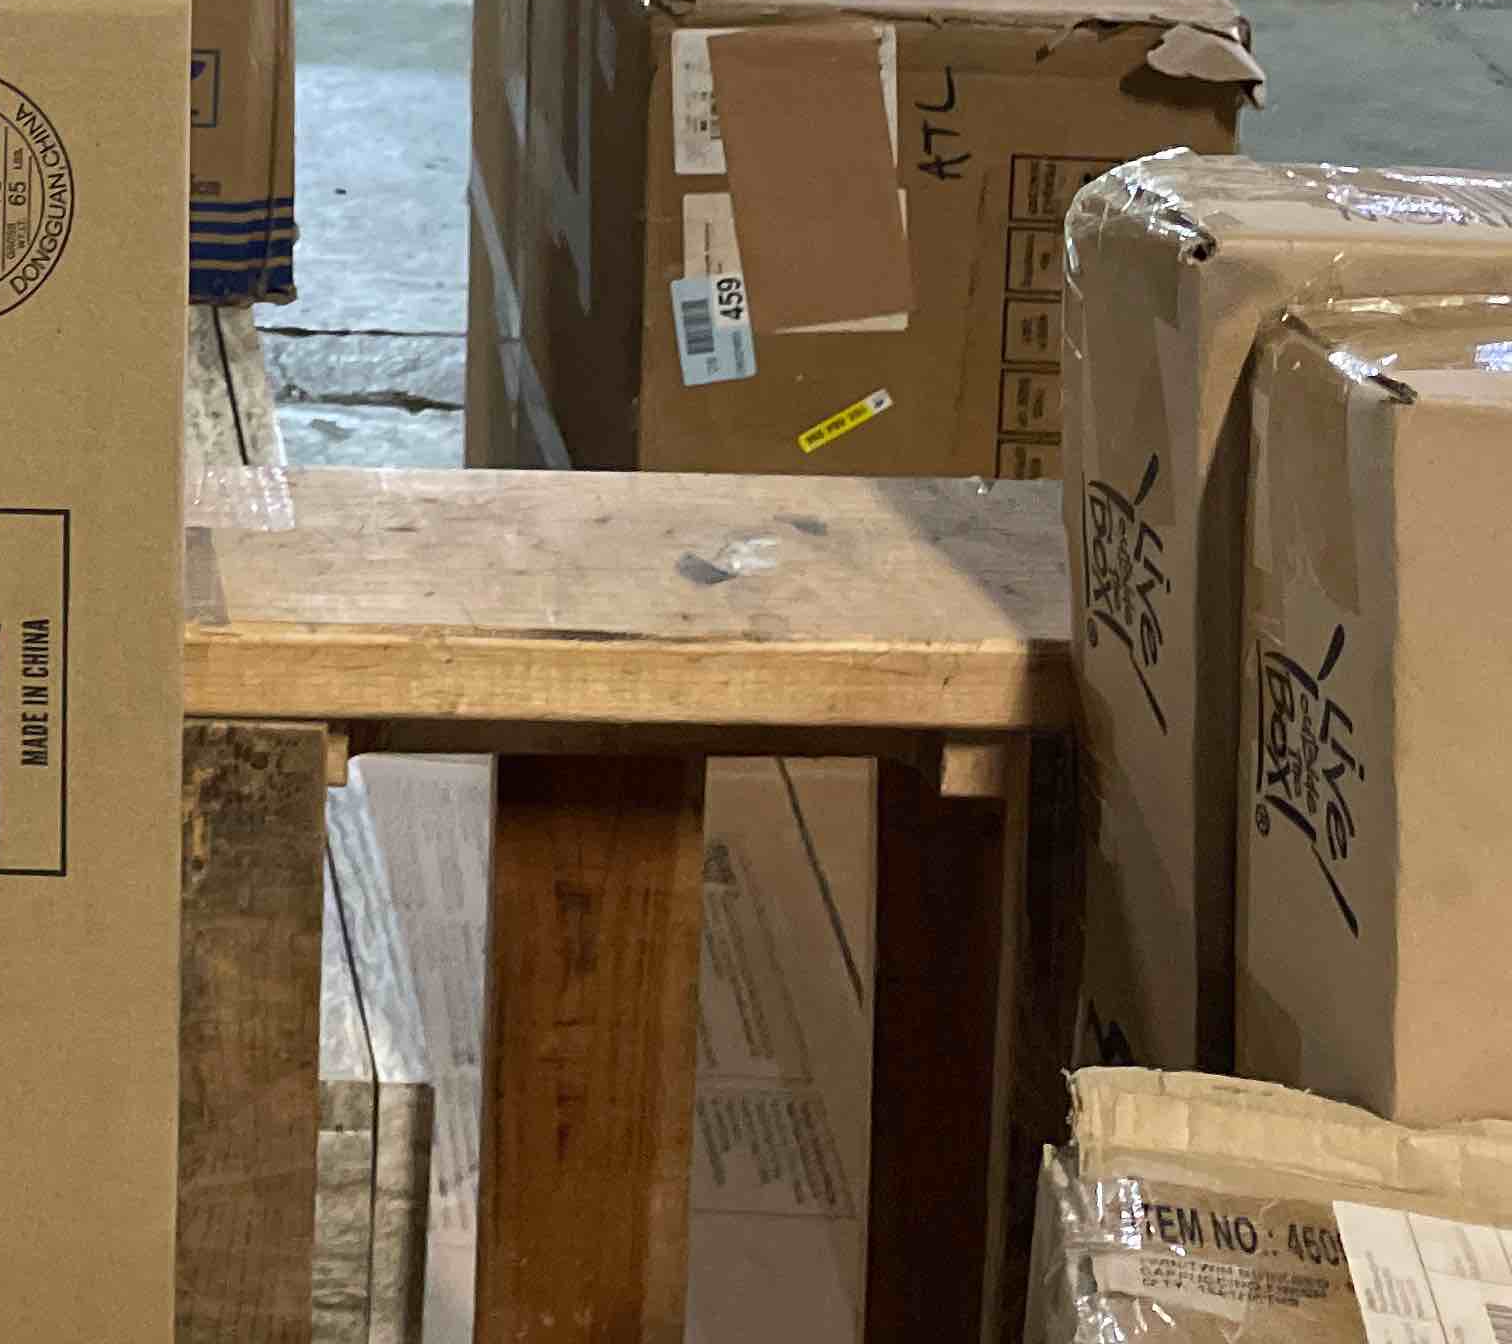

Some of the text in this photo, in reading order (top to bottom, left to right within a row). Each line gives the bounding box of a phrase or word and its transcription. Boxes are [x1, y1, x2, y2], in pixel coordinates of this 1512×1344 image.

[915, 66, 972, 181] ATL
[8, 181, 26, 207] 65
[716, 277, 745, 321] 459
[20, 617, 51, 767] MADE IN CHINA
